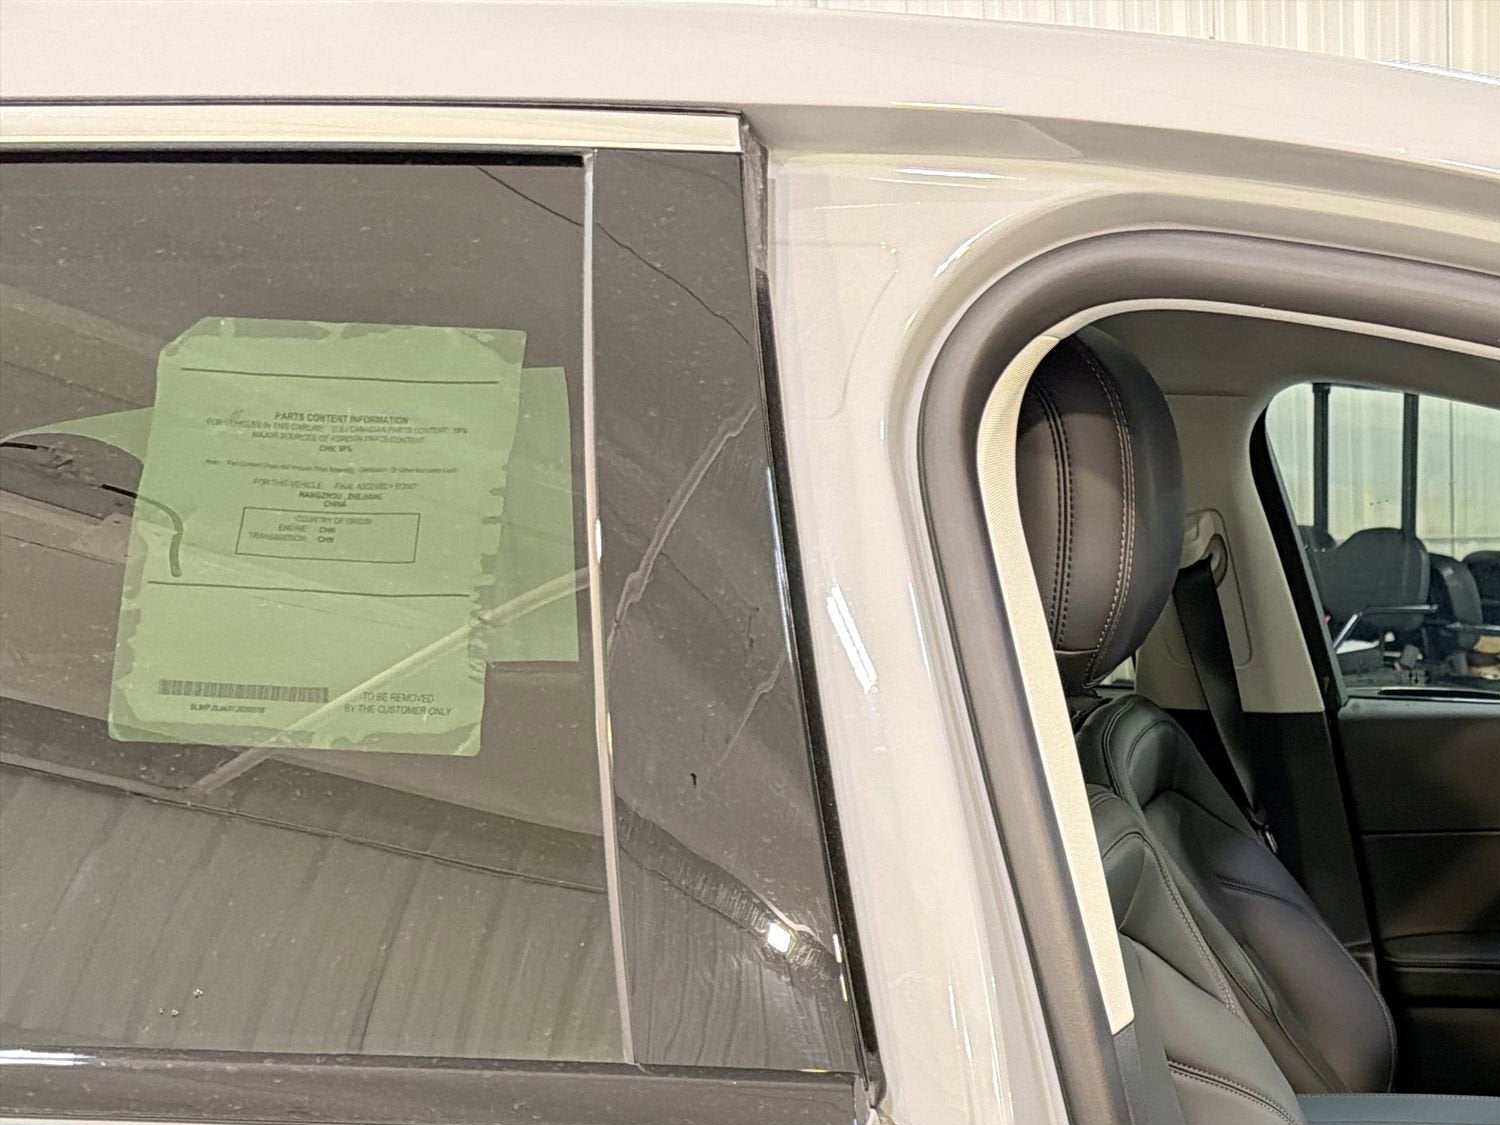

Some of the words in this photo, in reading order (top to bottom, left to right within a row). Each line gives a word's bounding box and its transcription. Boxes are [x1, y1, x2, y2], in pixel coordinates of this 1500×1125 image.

[274, 411, 305, 421] PARTS
[306, 412, 348, 424] CONTENT
[349, 415, 409, 424] INFORMATION
[376, 692, 389, 702] BE
[390, 692, 434, 704] REMOVED
[358, 703, 375, 714] THE
[376, 704, 426, 715] CUSTOMER
[427, 706, 452, 717] ONLY
